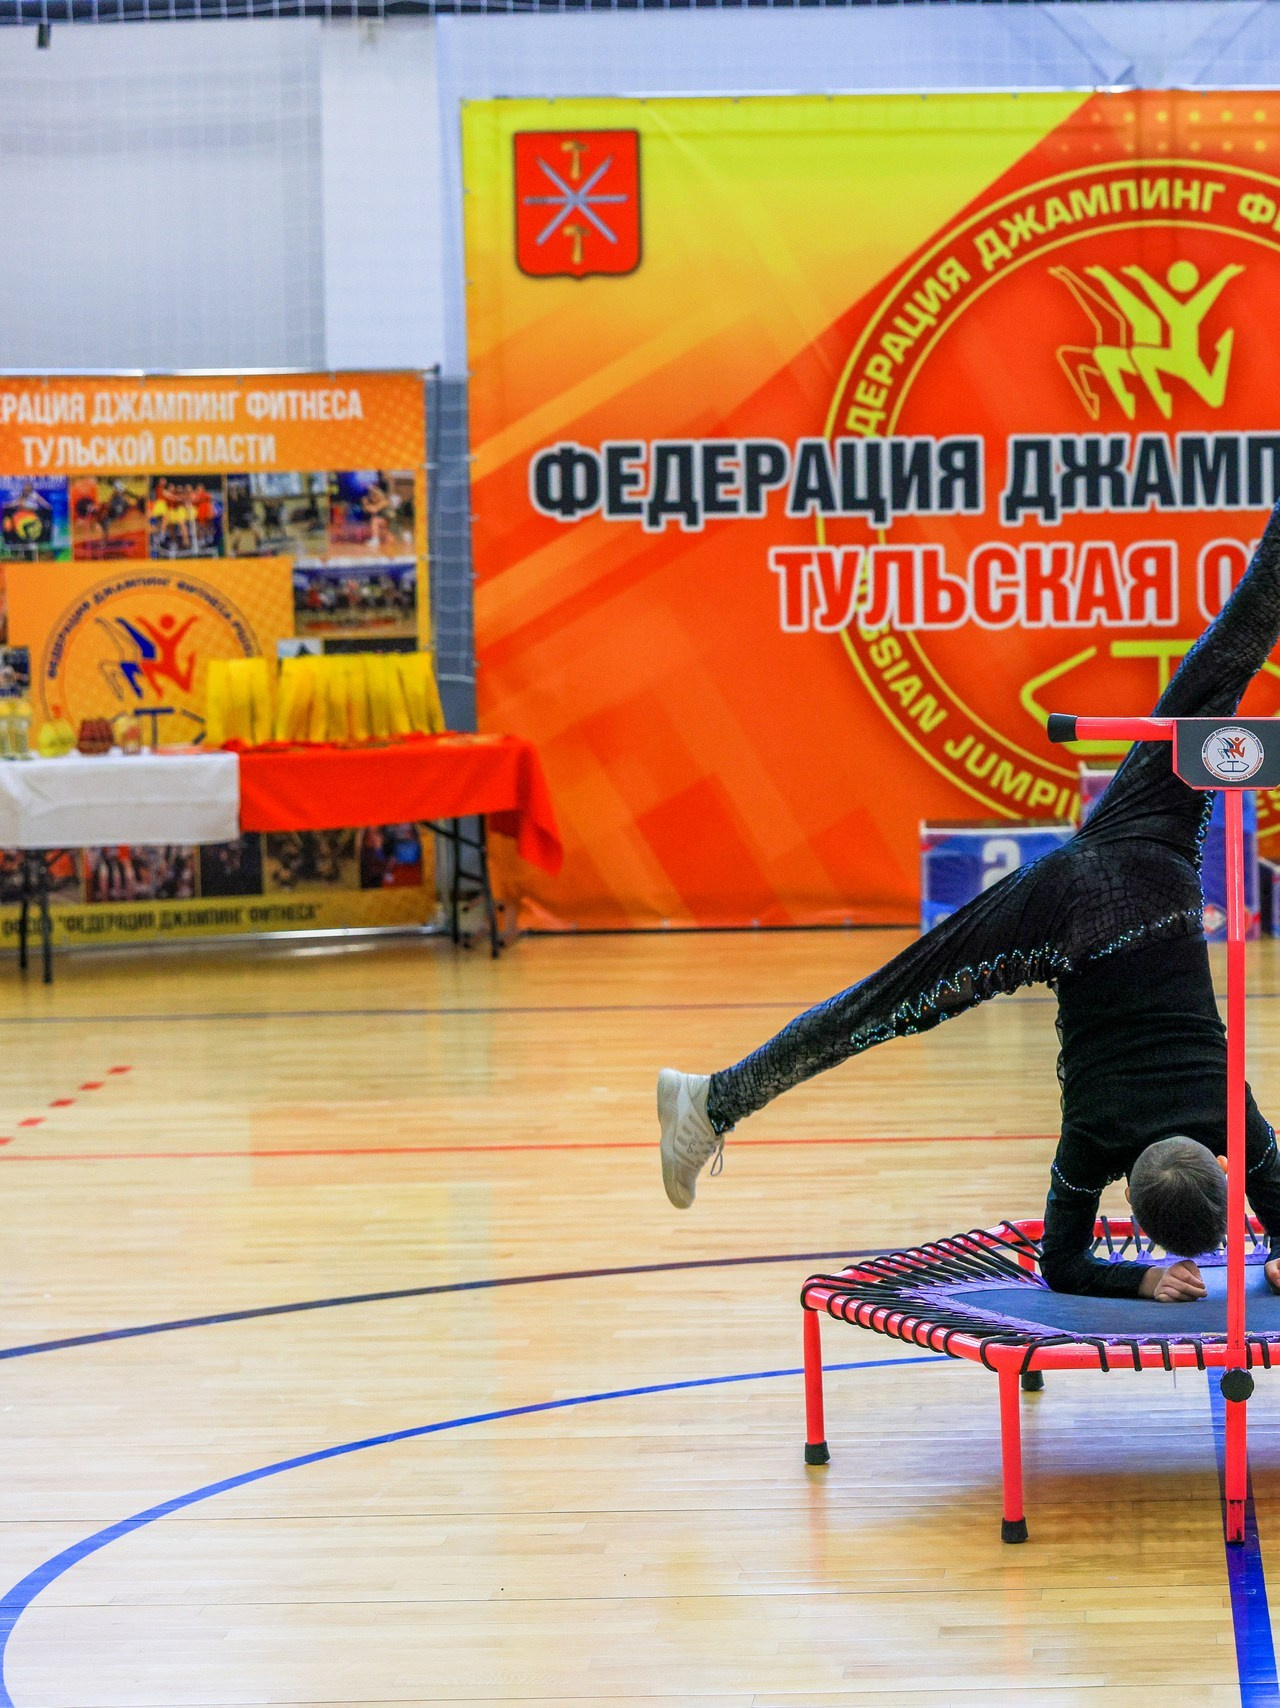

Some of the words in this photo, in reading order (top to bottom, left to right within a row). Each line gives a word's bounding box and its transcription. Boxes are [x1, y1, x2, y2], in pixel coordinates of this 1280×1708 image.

[845, 256, 972, 438] ДЕРАЦИЯ
[973, 178, 1226, 271] ДЖАМПИНГ
[0, 391, 86, 425] РАЦИЯ
[91, 391, 241, 426] ДЖАМПИНГ
[245, 389, 364, 422] ФИТНЕСА
[21, 430, 155, 468] ТУЛЬСКОЙ
[161, 434, 277, 467] ОБЛАСТИ
[530, 436, 985, 531] ФЕДЕРАЦИЯ
[770, 542, 1179, 631] ТУЛЬСКАЯ
[943, 735, 1081, 822] JUMPI
[982, 838, 1021, 892] 2
